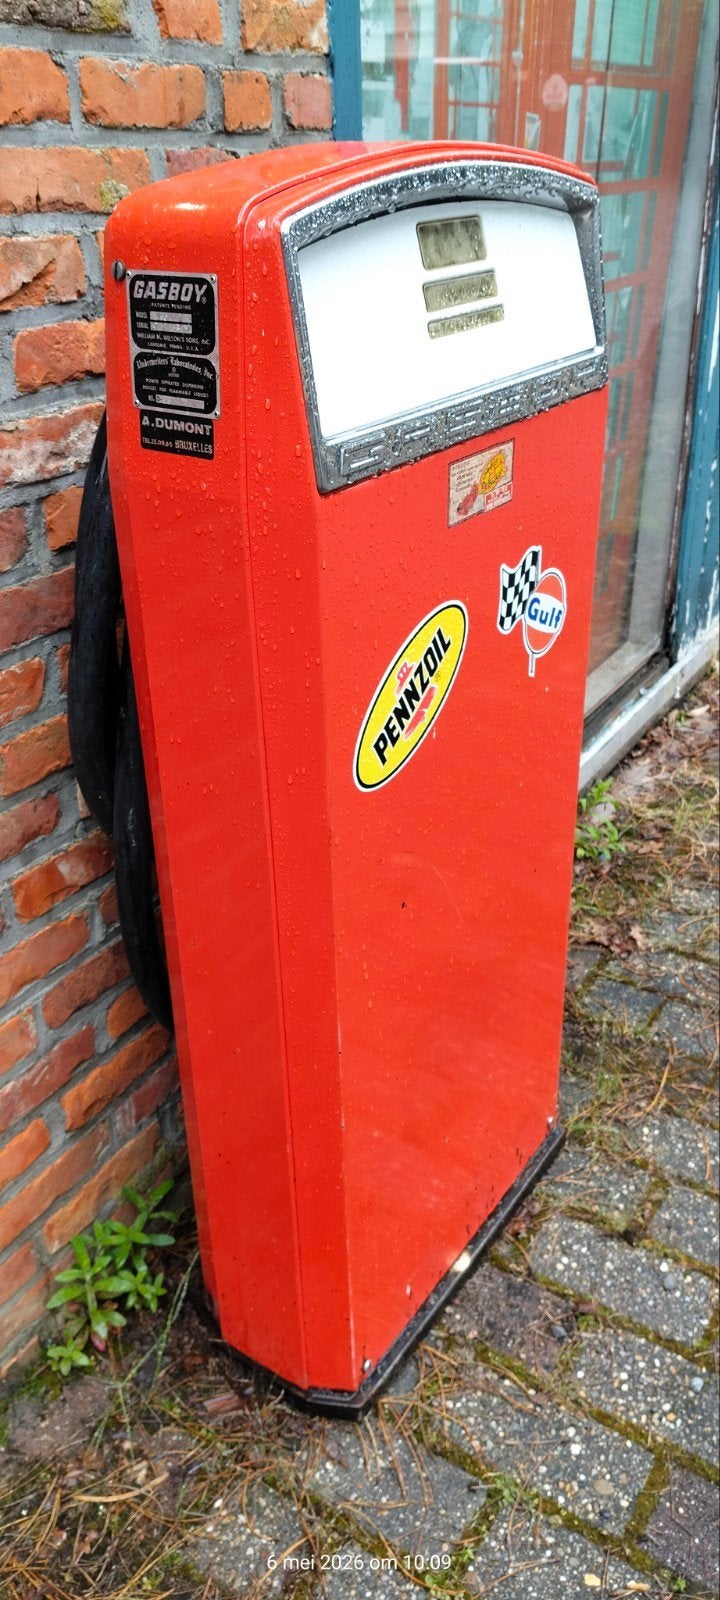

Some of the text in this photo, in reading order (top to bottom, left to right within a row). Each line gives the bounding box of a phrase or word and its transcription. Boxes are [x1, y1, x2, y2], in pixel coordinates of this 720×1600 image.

[133, 280, 208, 303] GASBOY
[174, 439, 213, 454] BRUXELLES
[527, 597, 562, 629] Gulf
[372, 627, 452, 766] PENNZOIL
